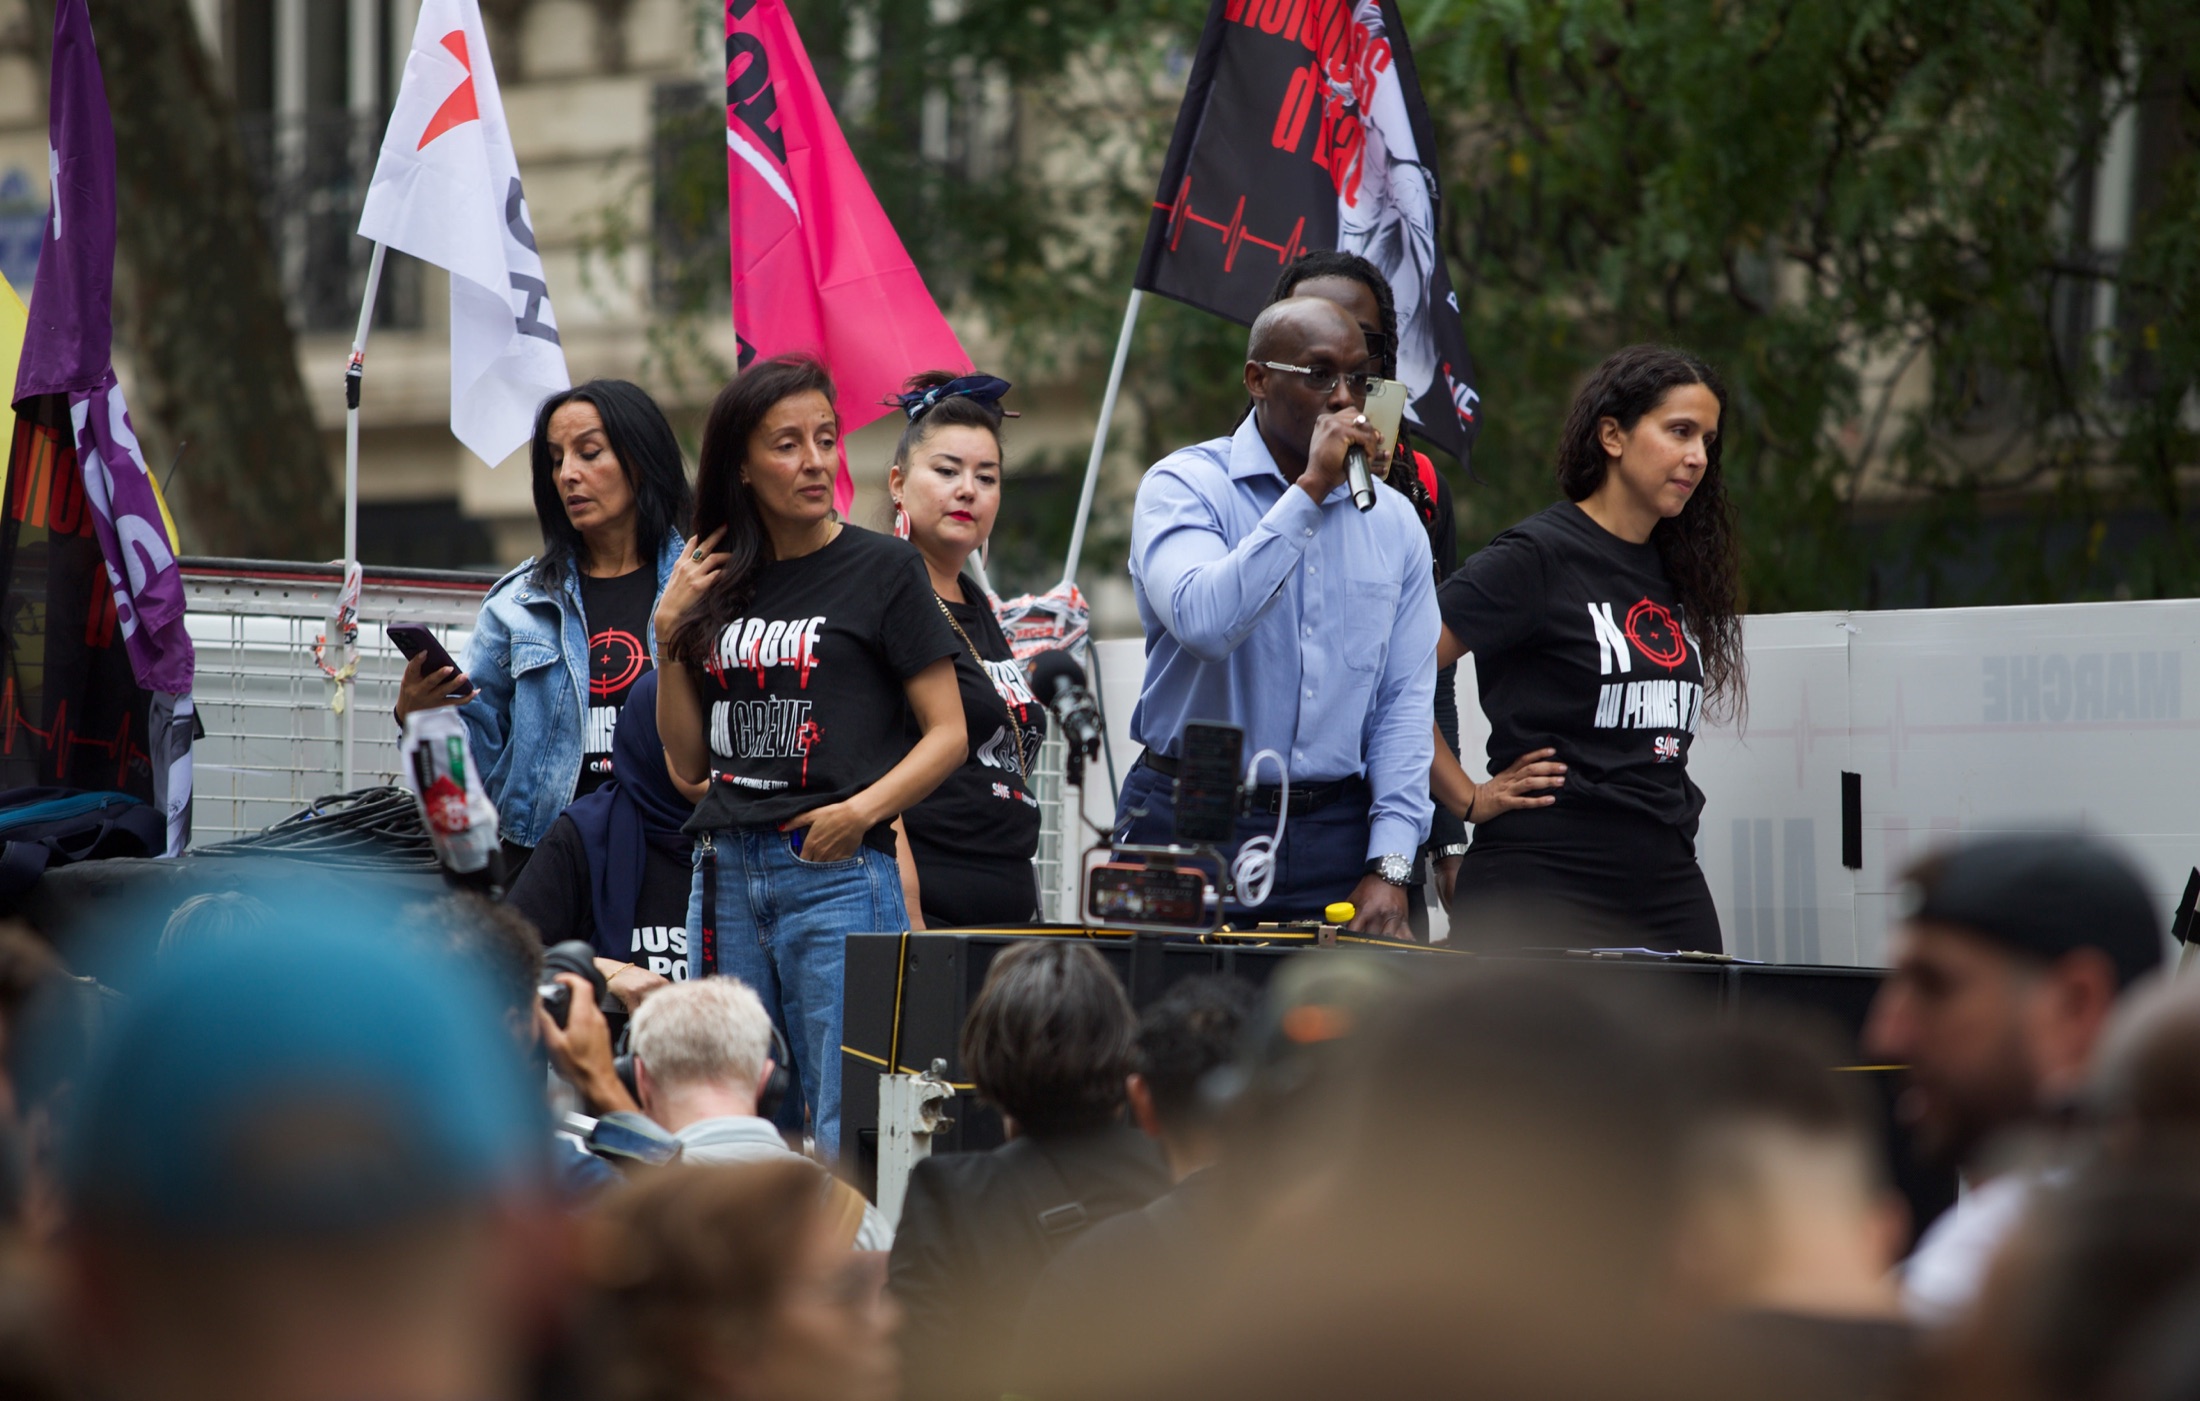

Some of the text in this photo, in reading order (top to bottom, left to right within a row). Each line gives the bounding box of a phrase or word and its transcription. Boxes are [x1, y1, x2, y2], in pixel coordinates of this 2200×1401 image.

[703, 616, 827, 673] ARCHE
[1594, 683, 1624, 728] AU
[1622, 680, 1679, 729] PERMIS
[1653, 735, 1680, 758] SAVE
